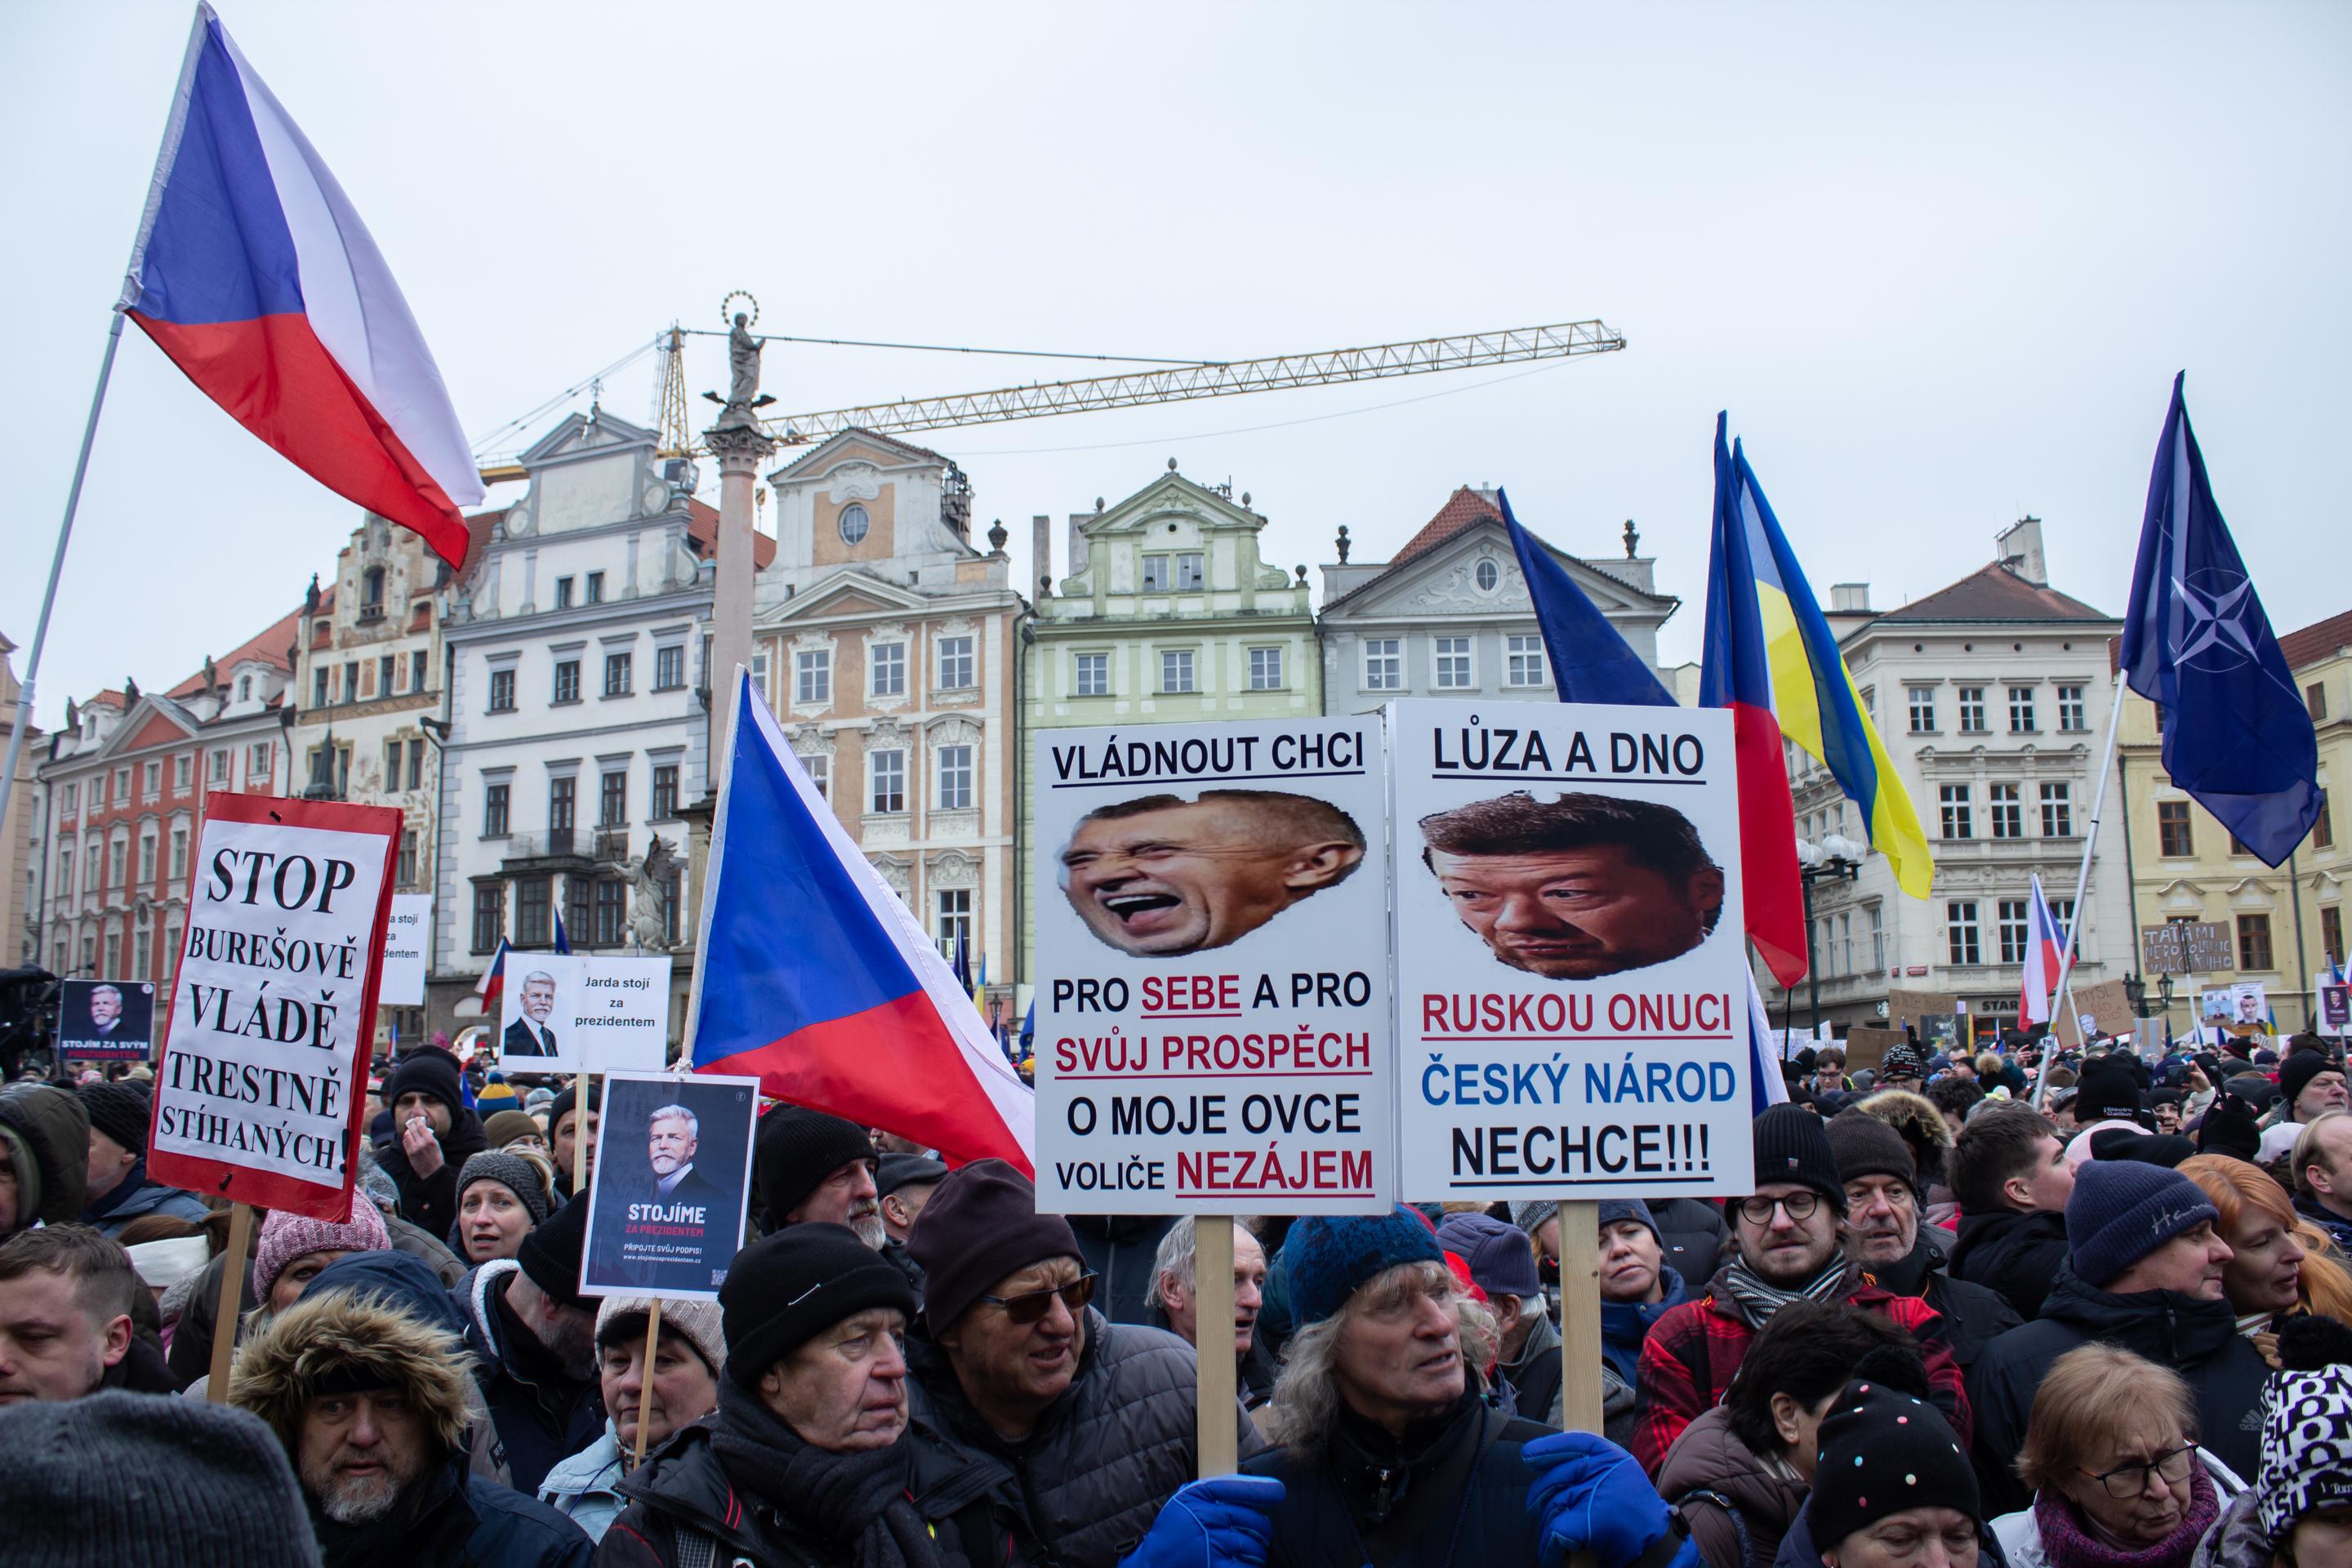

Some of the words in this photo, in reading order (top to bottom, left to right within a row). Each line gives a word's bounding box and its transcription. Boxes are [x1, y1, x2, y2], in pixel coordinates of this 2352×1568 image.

[1052, 734, 1259, 781] VLÁDNOUT
[1272, 732, 1363, 769] CHCI
[1435, 715, 1552, 772] LŮZA
[1566, 731, 1597, 773] A
[1611, 732, 1704, 776] DNO
[207, 848, 356, 914] STOP
[399, 914, 419, 925] stojí
[187, 926, 357, 979] BUREŠOVĚ
[585, 976, 619, 988] Jarda
[622, 977, 650, 991] stojí
[609, 998, 624, 1008] za
[1054, 978, 1129, 1013] PRO
[1142, 974, 1240, 1012] SEBE
[1252, 974, 1279, 1009] A
[1292, 971, 1371, 1008] PRO
[190, 980, 339, 1050] VLÁDĚ
[575, 1015, 656, 1028] prezidentem
[1423, 993, 1593, 1032] RUSKOU
[1608, 993, 1731, 1031] ONUCI
[1982, 1000, 2020, 1011] STAR
[61, 1039, 100, 1049] STOJÍM
[119, 1040, 148, 1049] SVÝM
[1055, 1026, 1147, 1071] SVŮJ
[1163, 1024, 1370, 1071] PROSPĚCH
[168, 1050, 342, 1119] TRESTNĚ
[1423, 1054, 1570, 1106] ČESKÝ
[1586, 1052, 1736, 1104] NÁROD
[1067, 1097, 1097, 1136] O
[1112, 1094, 1227, 1135] MOJE
[1242, 1093, 1361, 1134] OVCE
[1056, 1155, 1165, 1191] VOLIČE
[1178, 1141, 1373, 1190] NEZÁJEM
[1453, 1124, 1711, 1176] NECHCE!!!
[626, 1224, 638, 1234] ZA
[639, 1225, 704, 1237] PREZIDENTEM
[628, 1201, 706, 1224] STOJÍME
[623, 1243, 656, 1252] PŘIPOJTE
[657, 1244, 675, 1254] SVŮJ
[675, 1246, 702, 1255] PODPIS!
[623, 1254, 702, 1264] www.stojimezaprezidentem.cz
